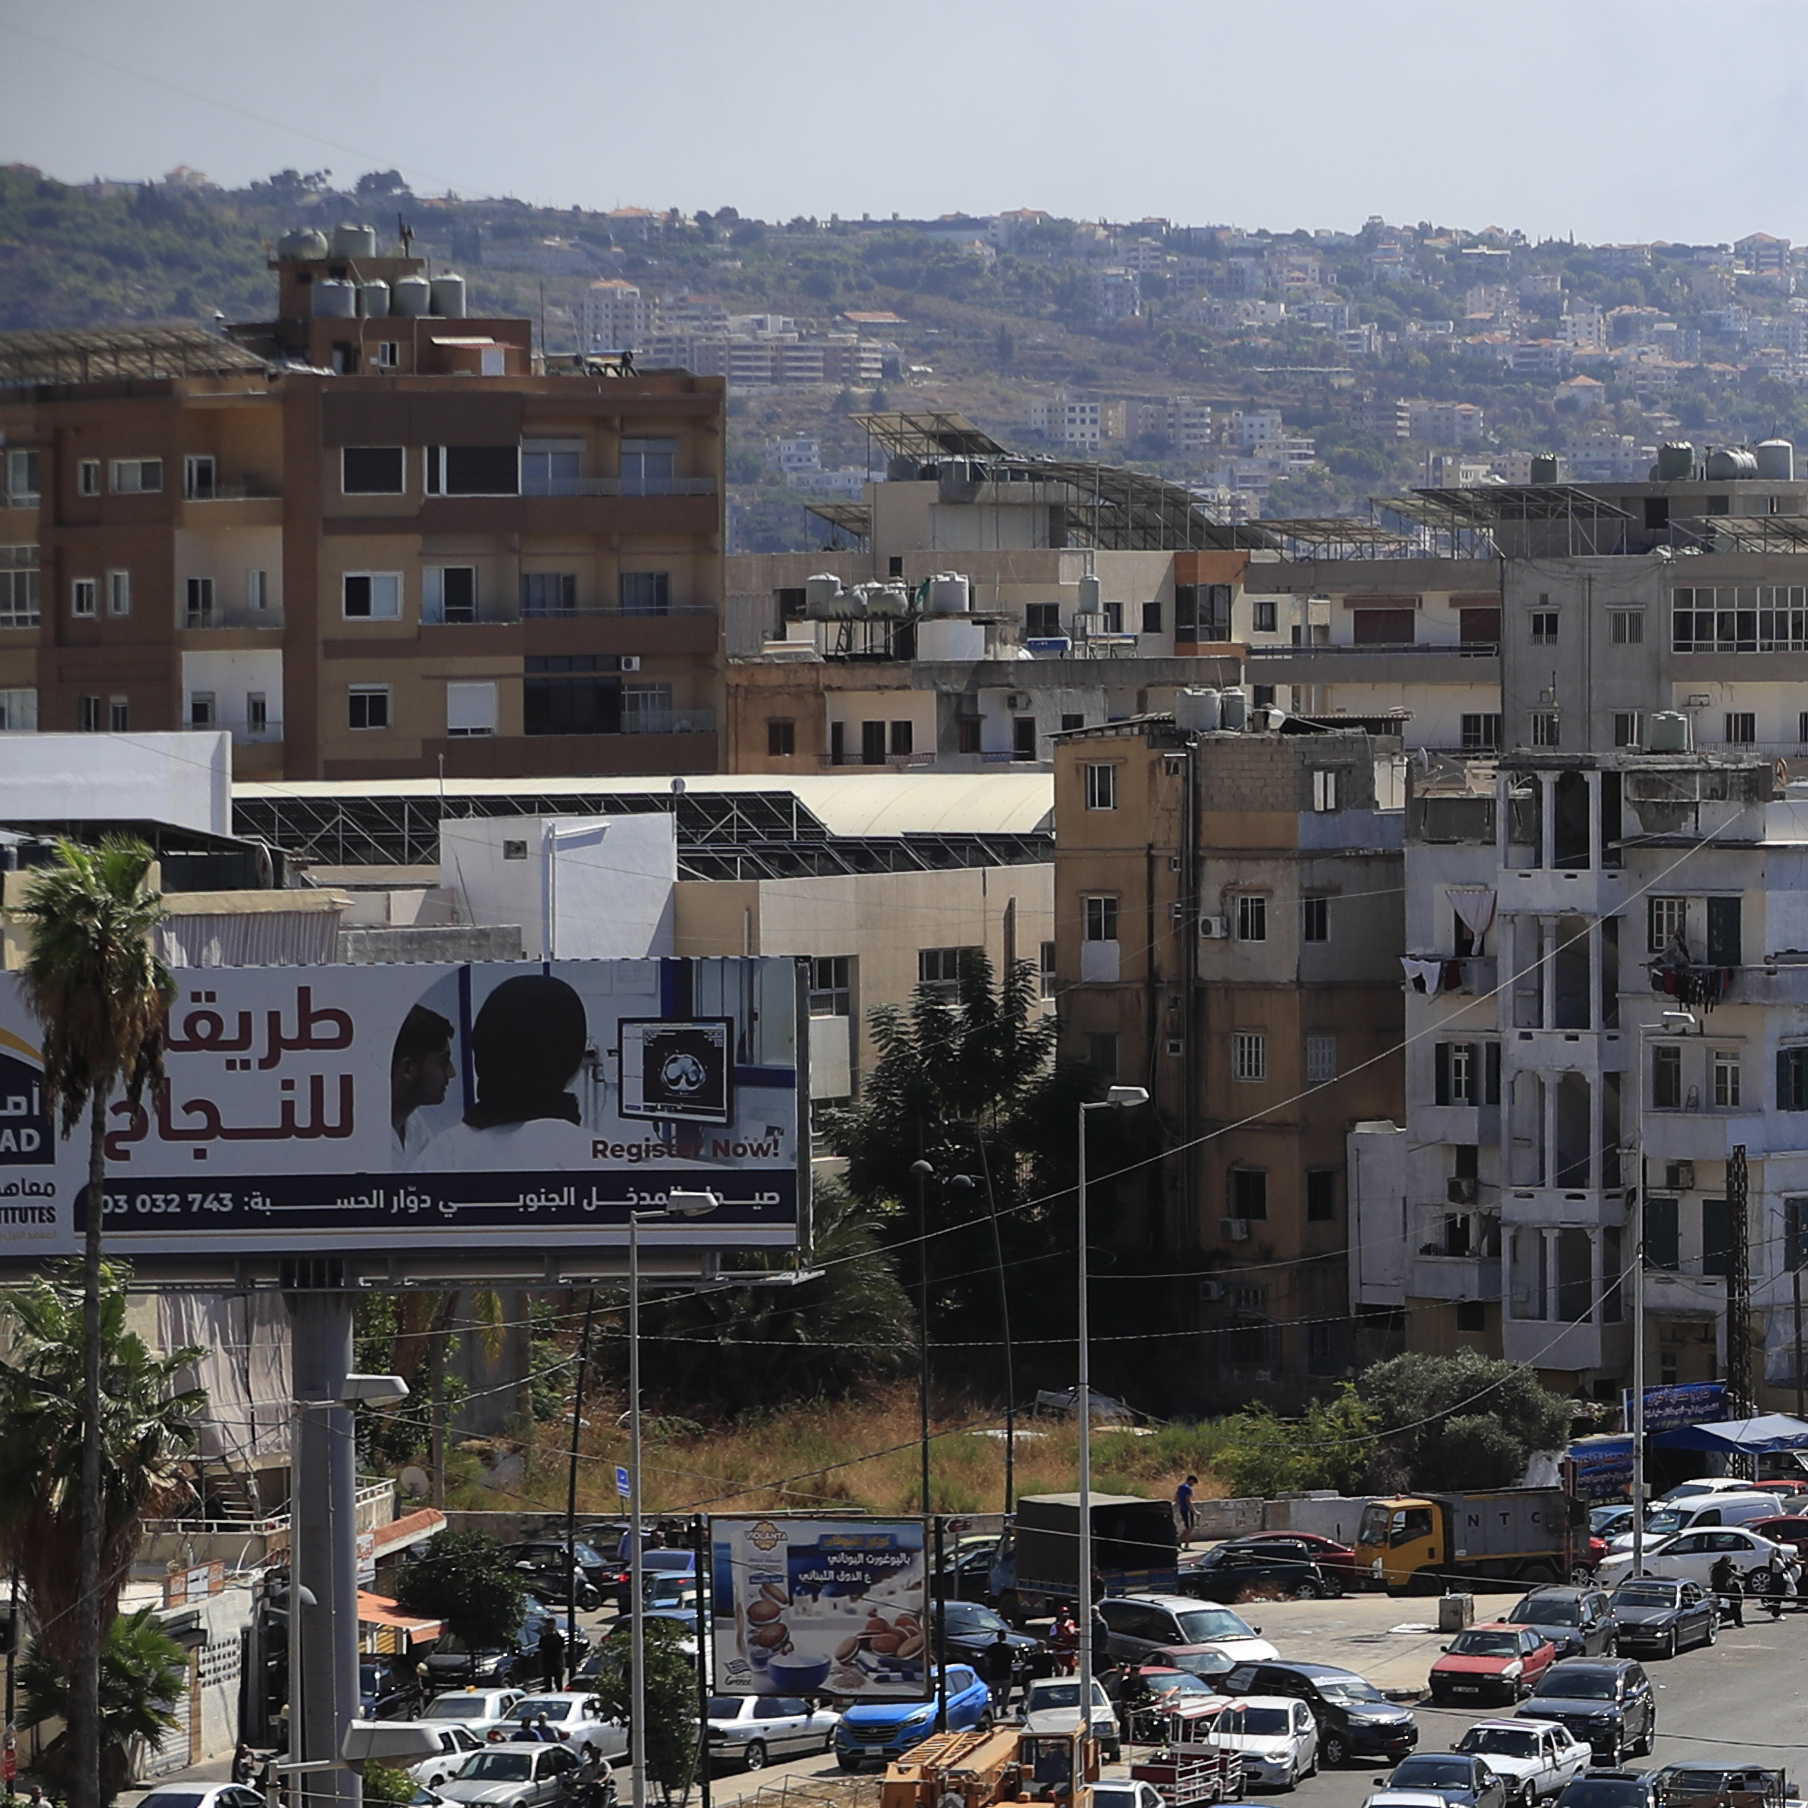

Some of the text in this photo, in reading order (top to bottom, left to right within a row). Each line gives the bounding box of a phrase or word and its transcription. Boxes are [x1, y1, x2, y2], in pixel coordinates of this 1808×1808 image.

[163, 985, 354, 1070] طريق
[104, 1073, 354, 1162] للنجاح
[592, 1134, 780, 1163] Register Now!
[136, 1194, 182, 1214] 032
[188, 1192, 234, 1213] 743
[438, 1187, 575, 1218] الجنوبي
